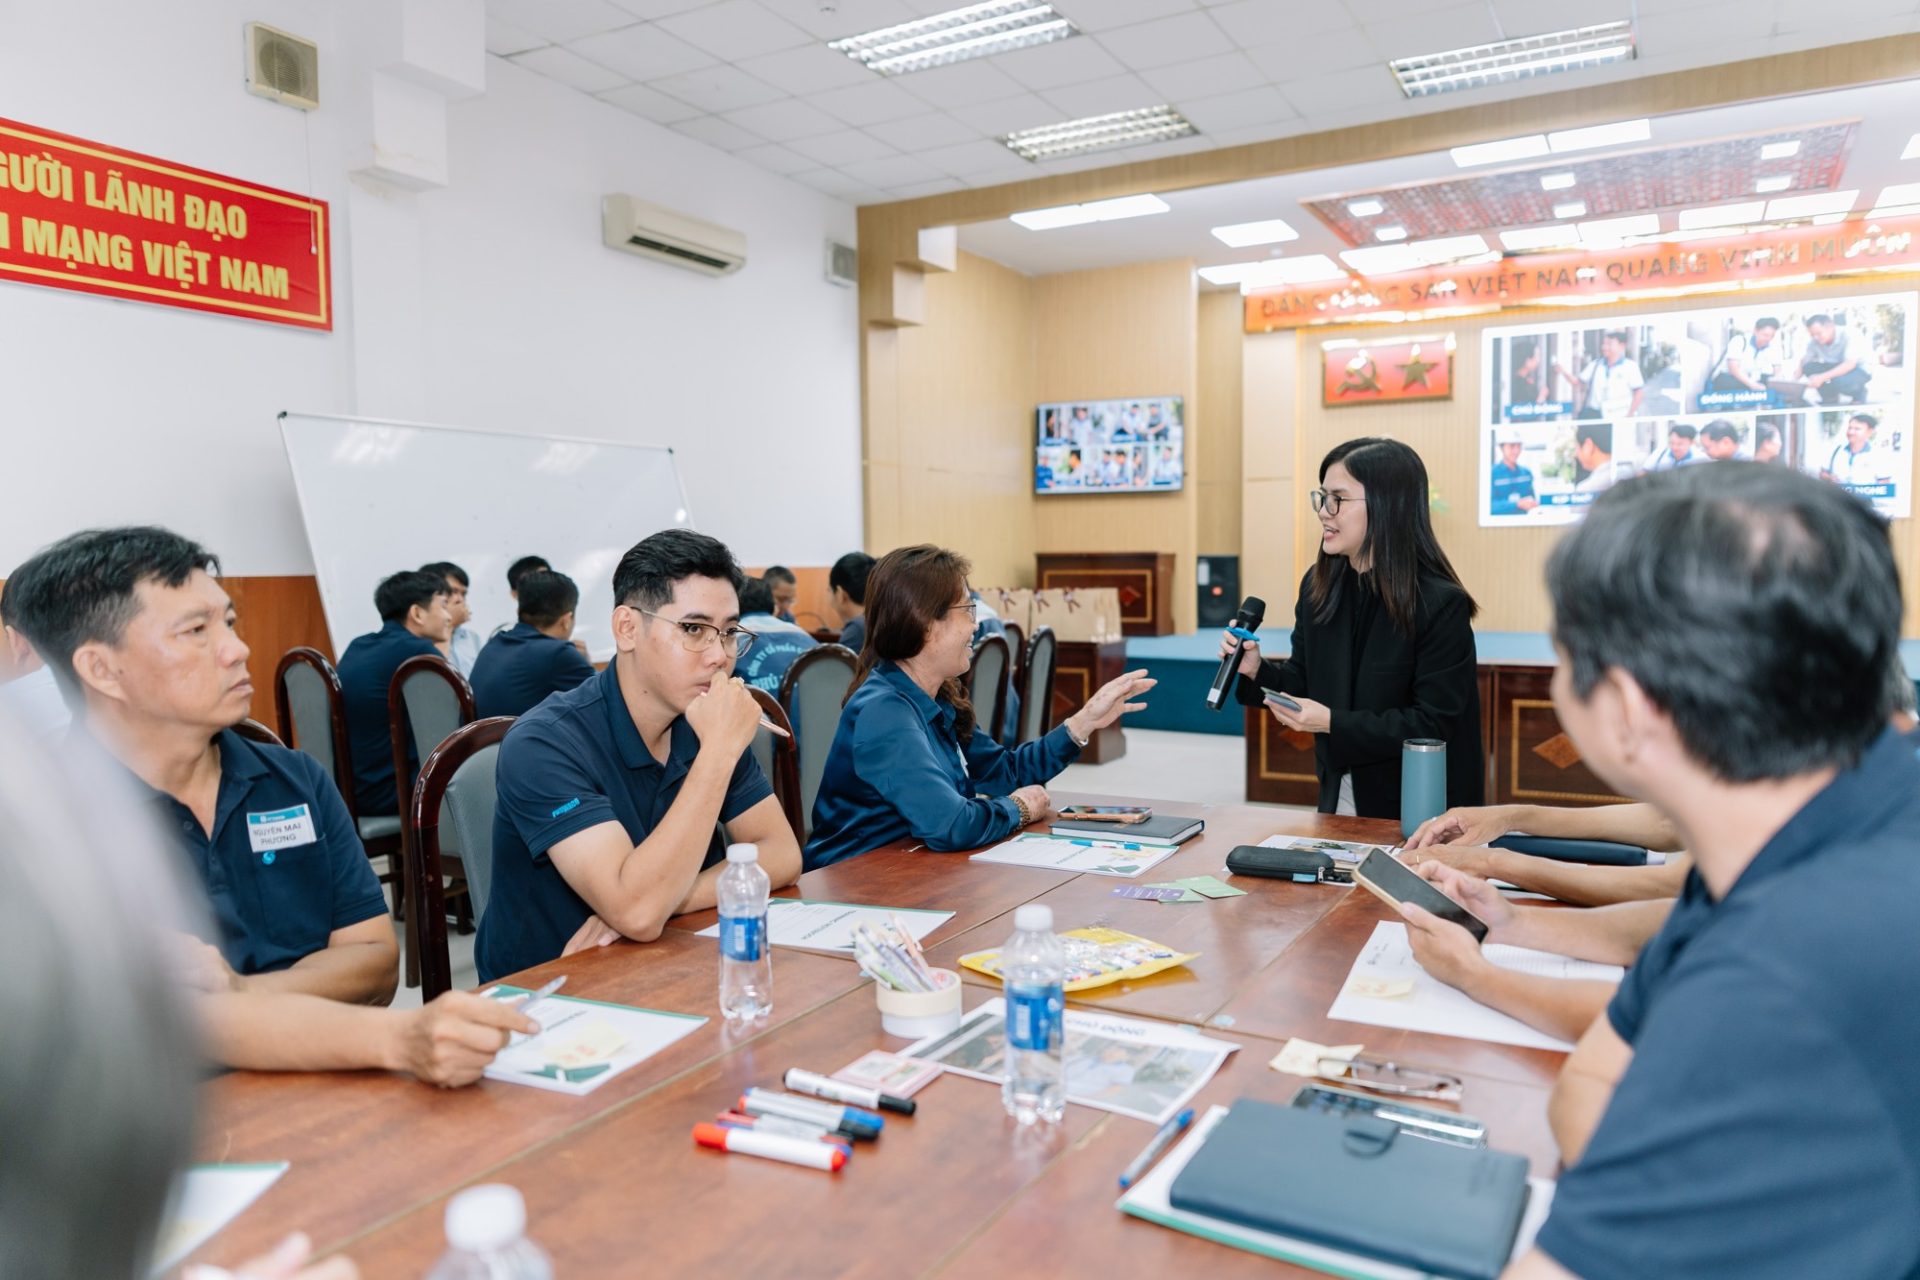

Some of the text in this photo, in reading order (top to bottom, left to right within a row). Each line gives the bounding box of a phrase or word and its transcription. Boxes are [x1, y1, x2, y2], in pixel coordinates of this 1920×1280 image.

[84, 169, 175, 225] LÃNH
[183, 193, 248, 242] ĐẠO
[21, 216, 134, 270] MẠNG
[142, 240, 212, 290] VIỆT
[219, 255, 290, 301] NAM
[1536, 266, 1597, 290] NAM
[1606, 251, 1708, 287] QUANG
